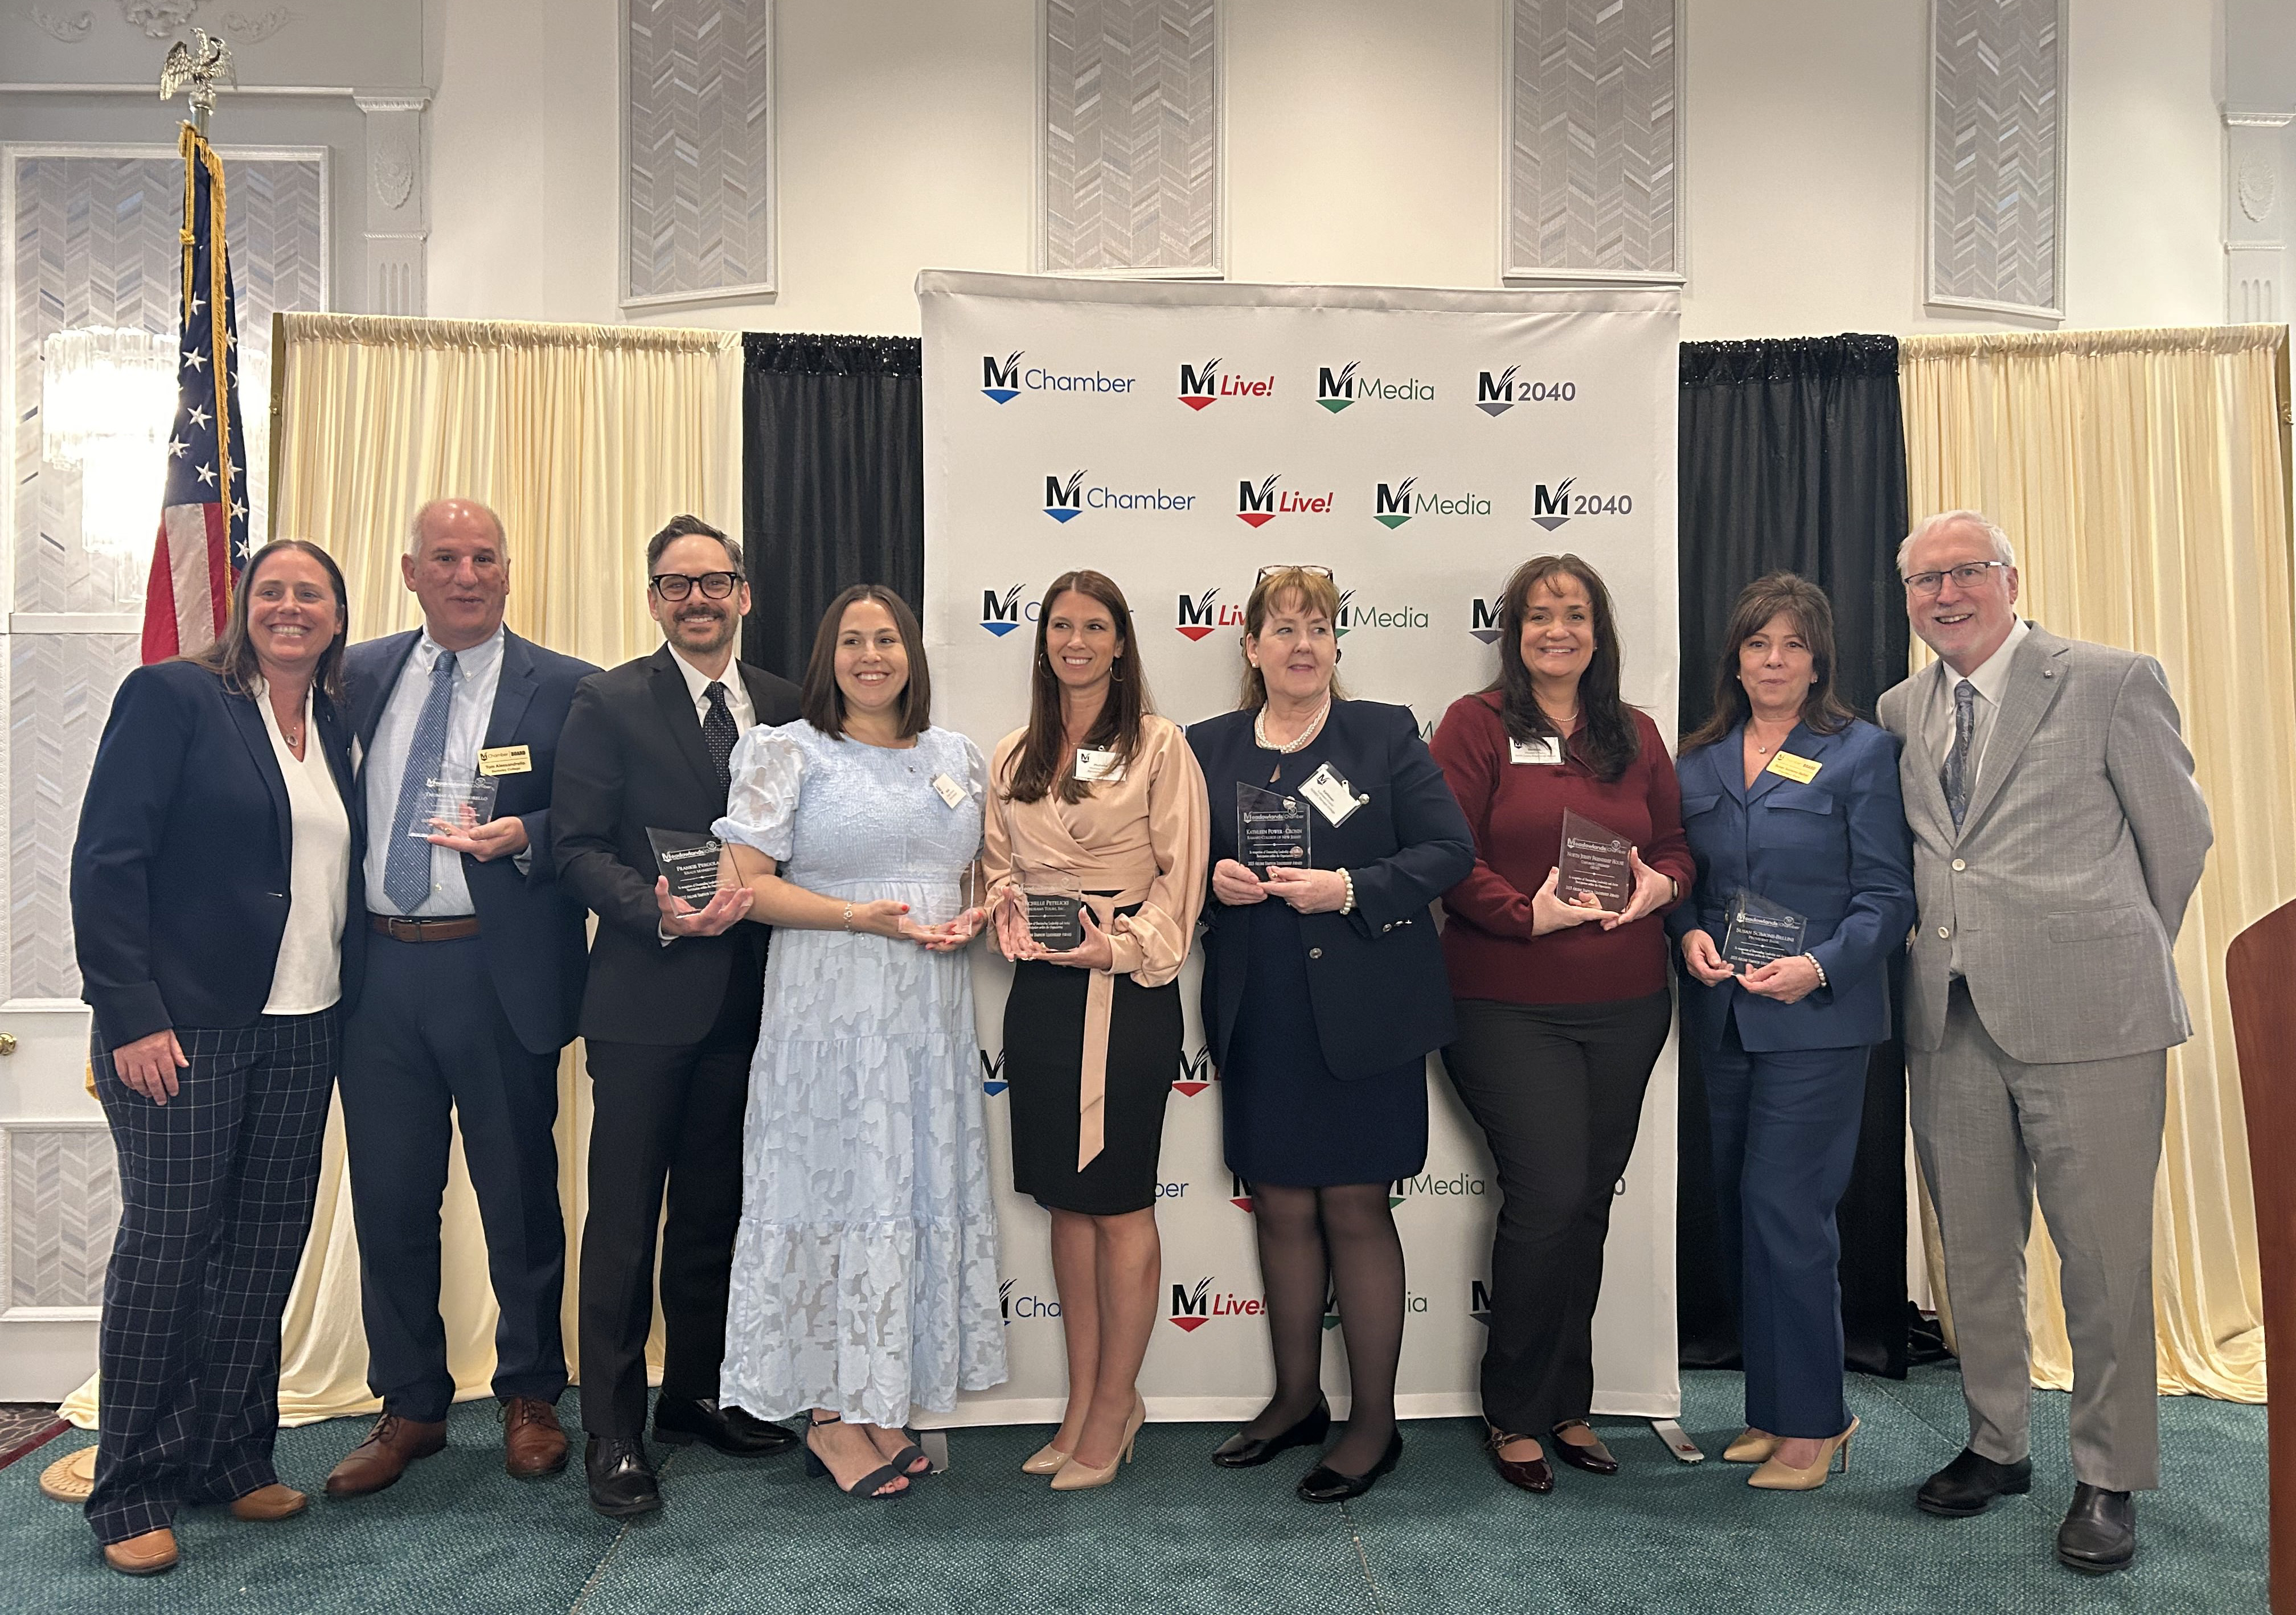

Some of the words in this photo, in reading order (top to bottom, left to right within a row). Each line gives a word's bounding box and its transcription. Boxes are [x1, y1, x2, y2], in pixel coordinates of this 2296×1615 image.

[1026, 368, 1136, 393] Chamber
[1221, 375, 1274, 396] Live!
[1358, 378, 1434, 400] Media
[1518, 383, 1576, 401] 2040
[1088, 487, 1196, 510] Chamber
[1280, 491, 1334, 513] Live!
[1415, 493, 1491, 515] Media
[1575, 495, 1632, 515] 2040
[1354, 605, 1429, 628] Media
[1409, 1173, 1485, 1195] Media
[1213, 1293, 1266, 1315] Live!
